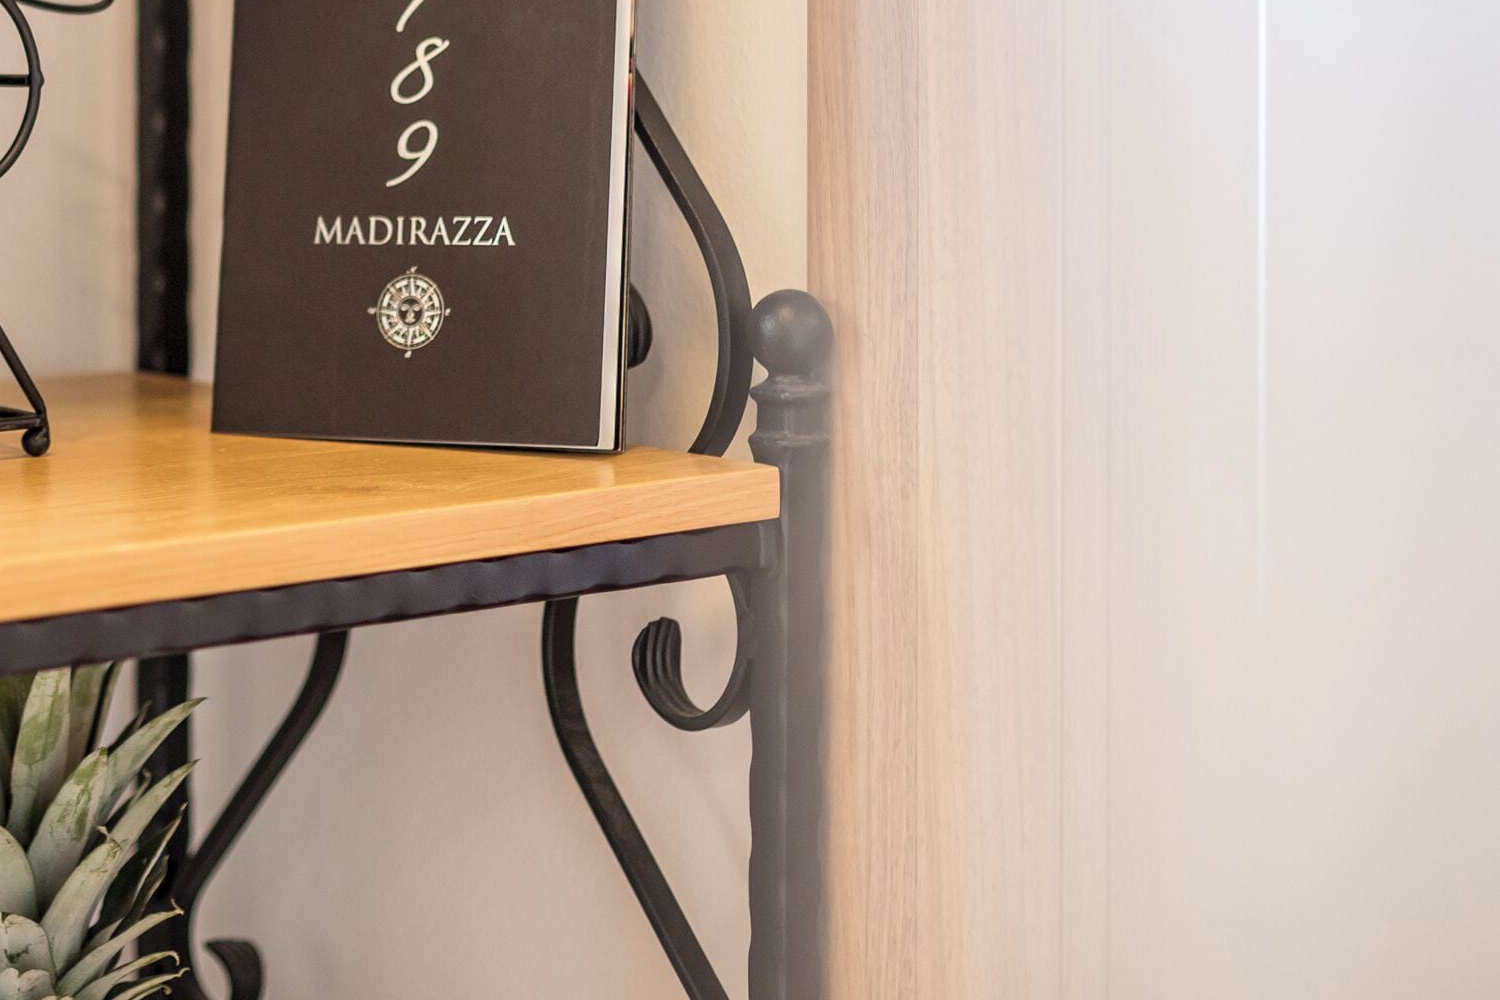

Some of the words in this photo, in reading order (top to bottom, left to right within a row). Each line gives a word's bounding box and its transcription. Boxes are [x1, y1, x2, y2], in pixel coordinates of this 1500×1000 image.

[389, 36, 451, 105] 8
[385, 119, 439, 188] 9
[313, 215, 517, 246] MADIRAZZA
